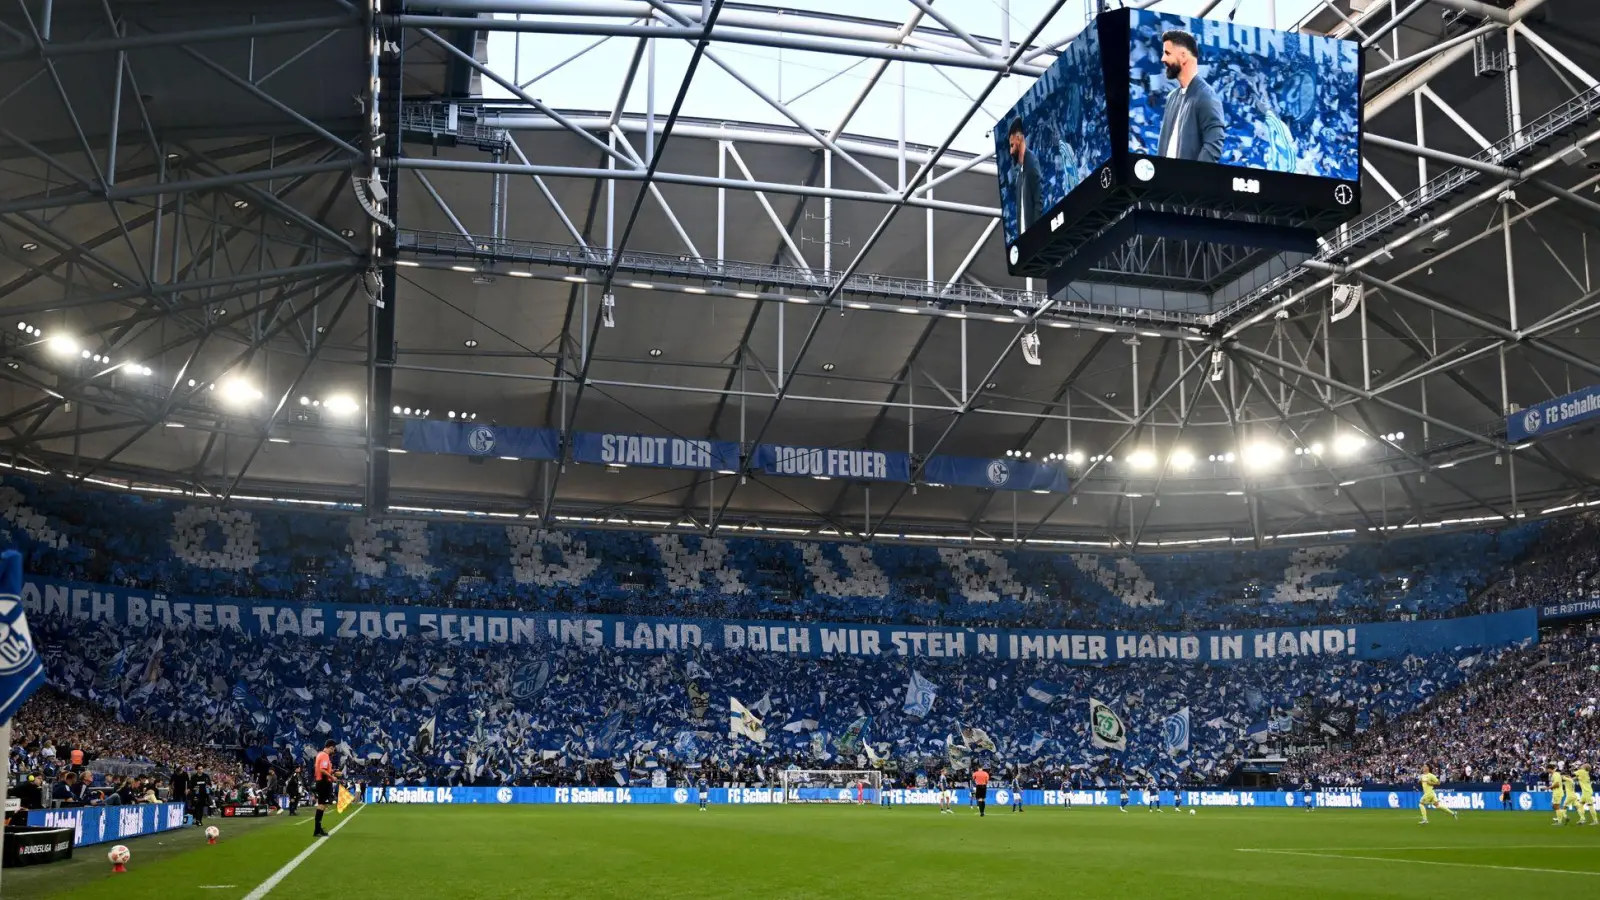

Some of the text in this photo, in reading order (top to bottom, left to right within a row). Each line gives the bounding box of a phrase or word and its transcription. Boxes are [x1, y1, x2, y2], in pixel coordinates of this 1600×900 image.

[1545, 394, 1600, 424] FC Schalke
[601, 434, 711, 467] STADT DER
[774, 446, 886, 478] 1000 FEUER
[1544, 606, 1558, 616] DIE
[22, 582, 115, 623] ANCH
[127, 594, 241, 633] BÖSER
[252, 606, 324, 636] TAG
[336, 611, 407, 640] ZOG
[419, 614, 536, 644] SCHON
[548, 619, 604, 646] INS
[724, 624, 810, 652] DOCH
[820, 628, 881, 655] WIR
[1009, 635, 1108, 660] IMMER
[1116, 635, 1200, 659] HAND
[1210, 635, 1243, 661] IN
[1254, 628, 1357, 658] HAND!
[388, 787, 434, 803] Schalke
[436, 787, 453, 803] 04
[555, 788, 632, 804] FC Schalke 04
[727, 789, 741, 804] FC
[891, 790, 903, 804] FC
[1044, 790, 1056, 804] FC
[1095, 791, 1109, 805] 04
[1188, 791, 1255, 806] FC Schalke 04
[1471, 792, 1485, 809] 04
[24, 843, 52, 855] BUNDESLIGA
